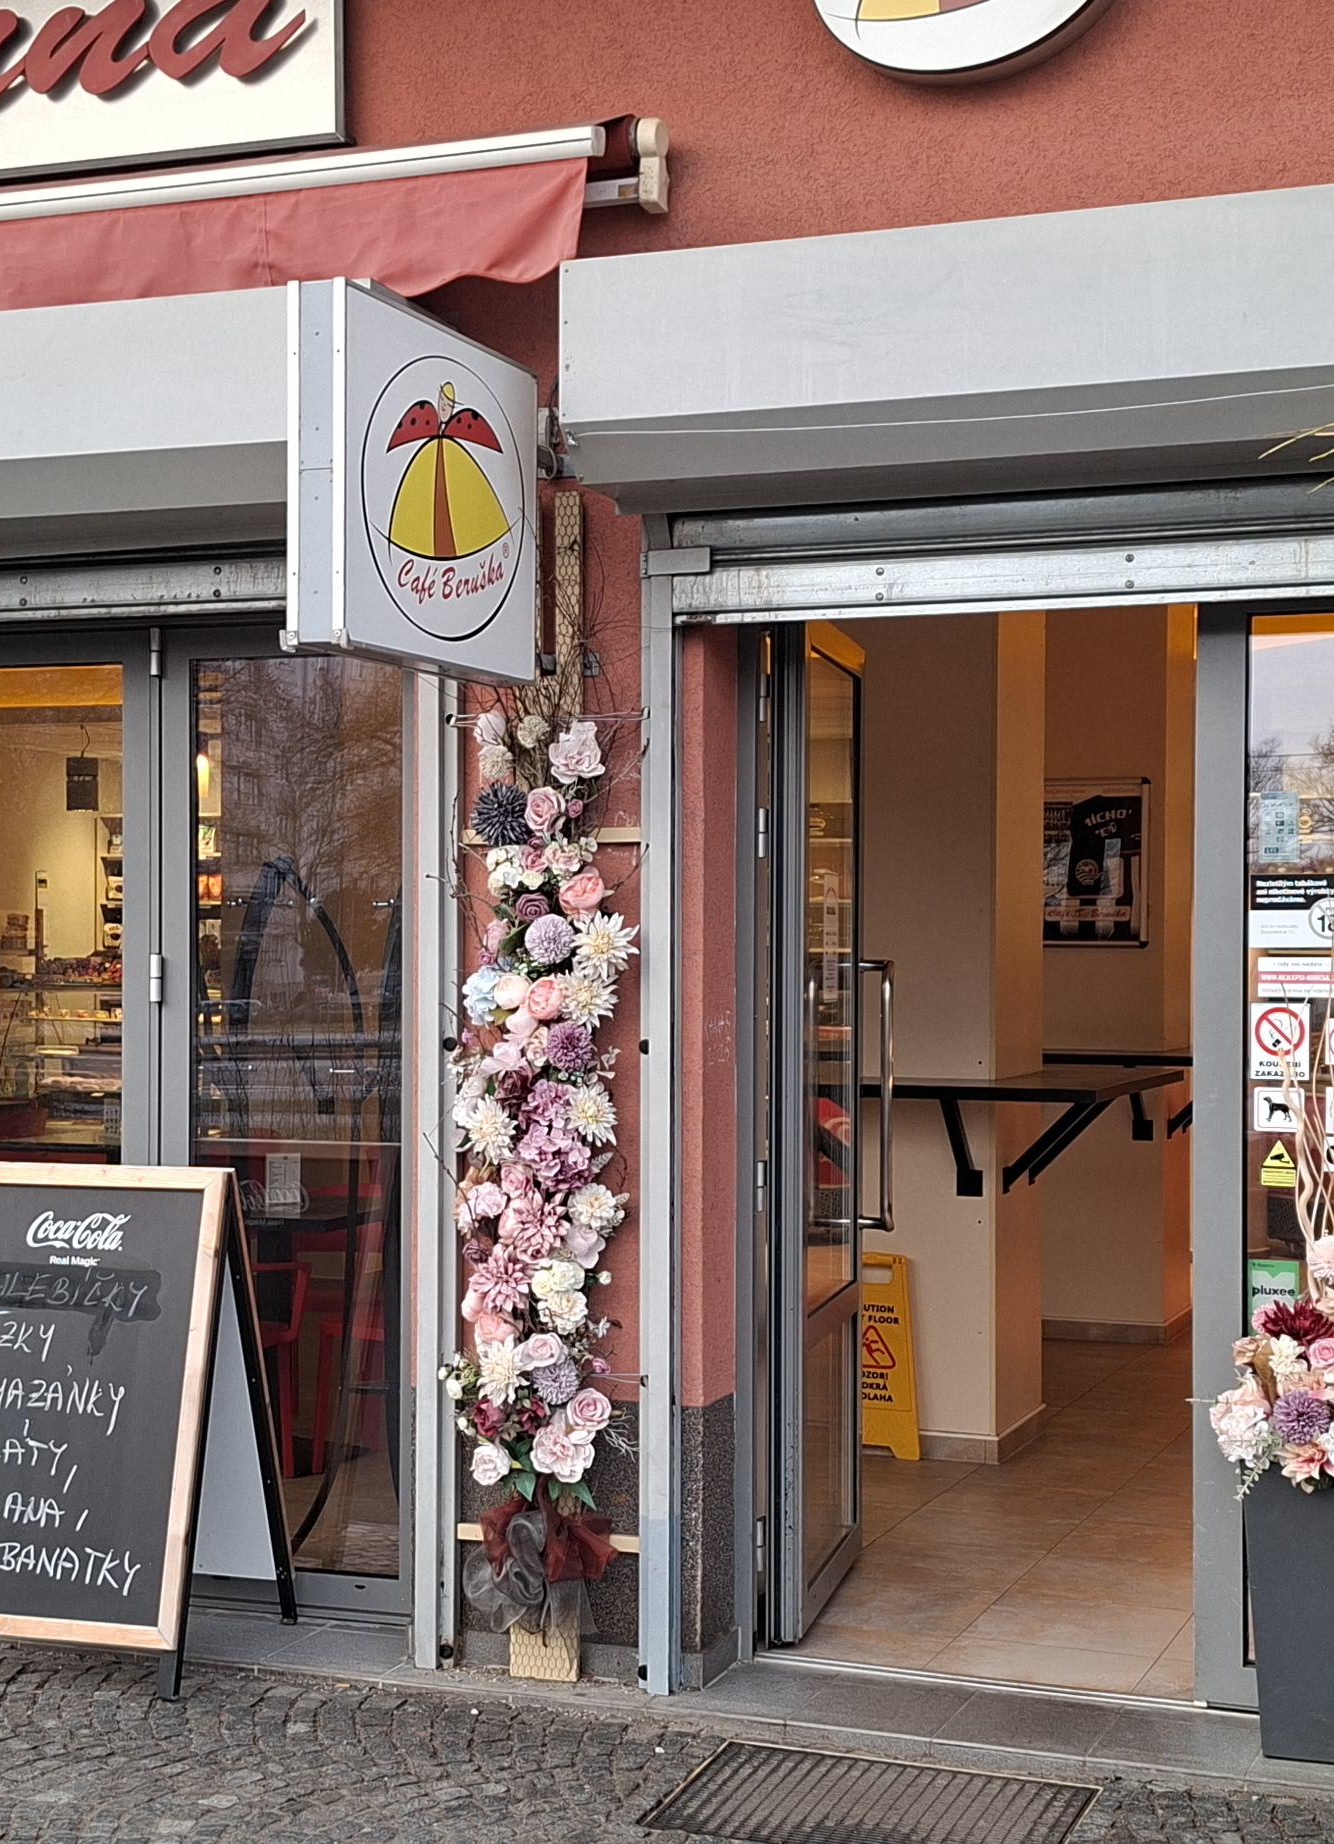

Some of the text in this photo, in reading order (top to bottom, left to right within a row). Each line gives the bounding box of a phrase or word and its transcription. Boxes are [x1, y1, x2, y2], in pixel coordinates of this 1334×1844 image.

[397, 552, 504, 605] Café Beruška
[26, 1210, 132, 1251] Coca-Cola
[49, 1255, 70, 1265] Real
[1252, 1285, 1296, 1298] pluxee
[863, 1303, 895, 1314] UTION
[868, 1315, 900, 1326] FLOOR
[862, 1370, 890, 1381] ZOR!
[862, 1380, 889, 1392] OKRÁ
[862, 1391, 894, 1403] OLAHA
